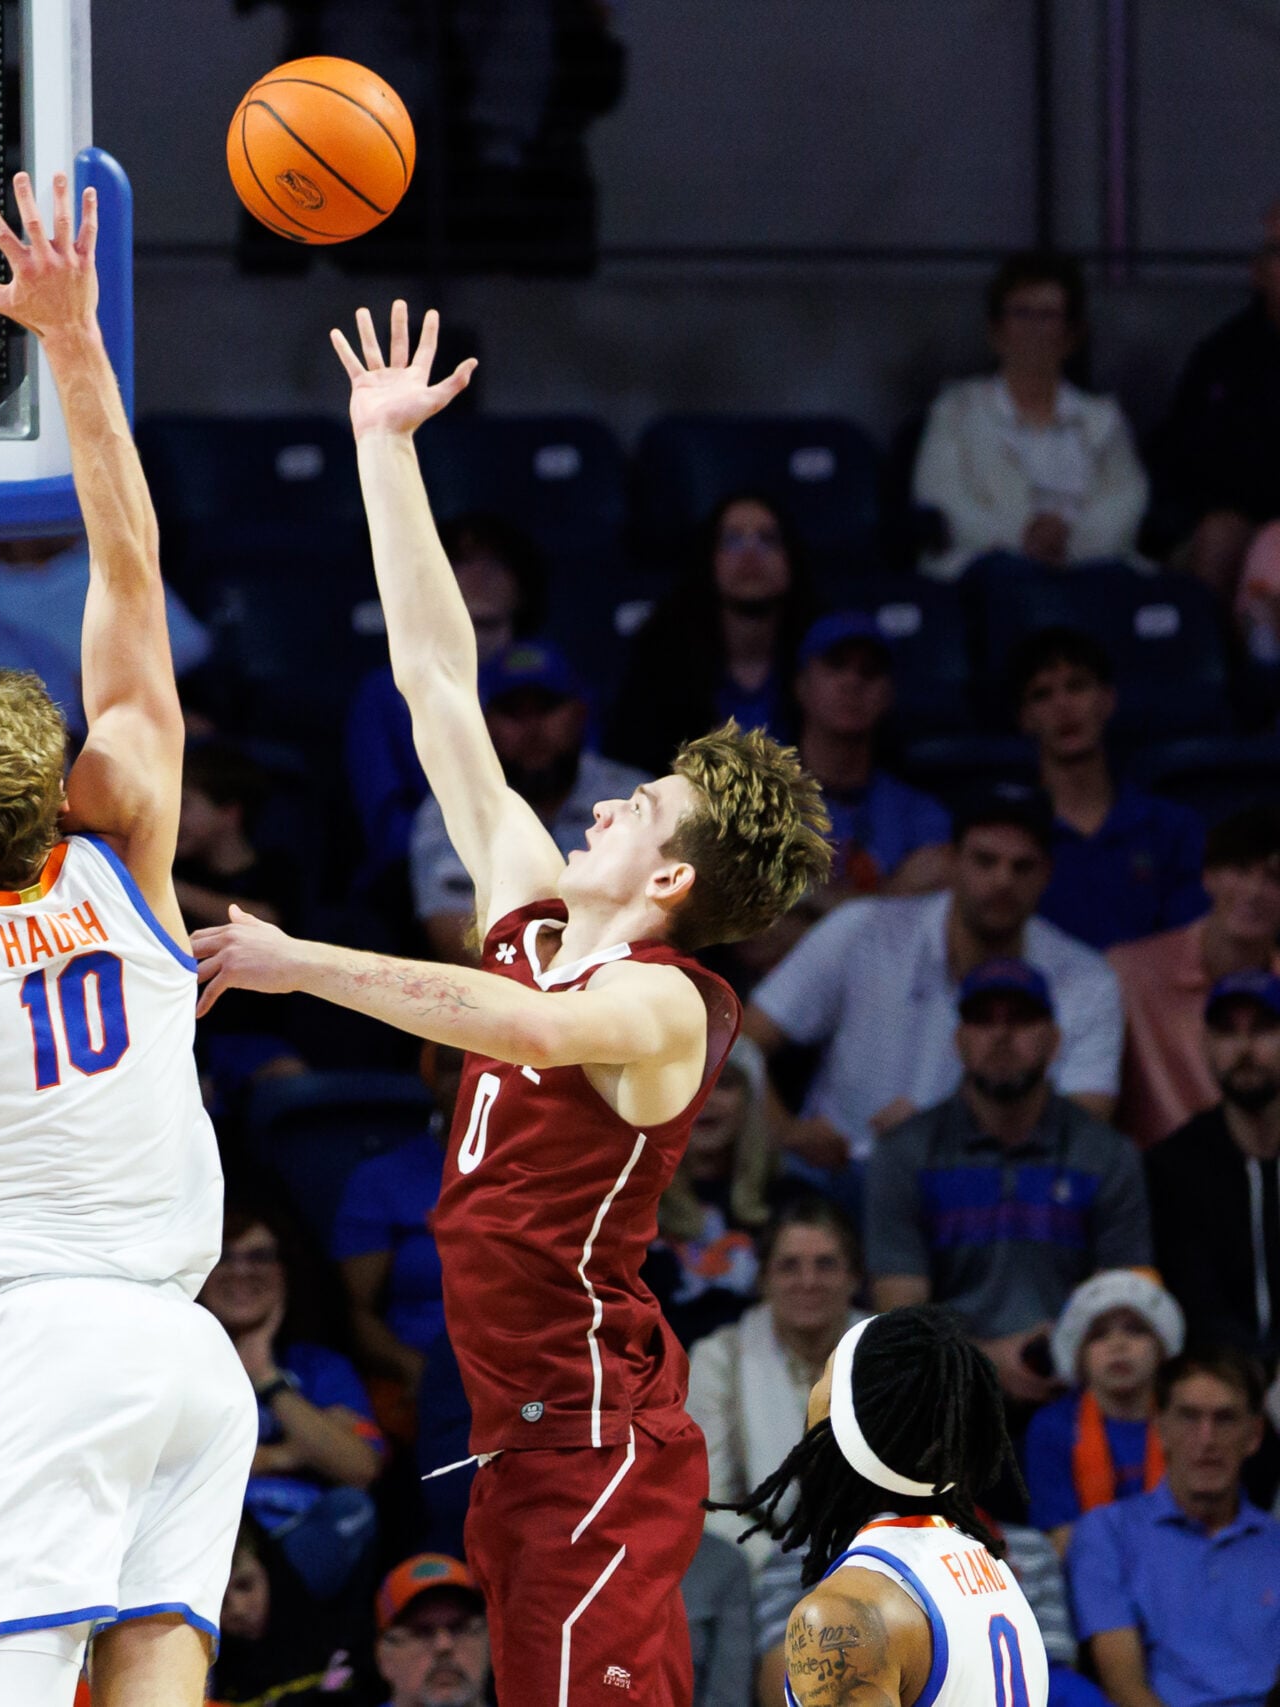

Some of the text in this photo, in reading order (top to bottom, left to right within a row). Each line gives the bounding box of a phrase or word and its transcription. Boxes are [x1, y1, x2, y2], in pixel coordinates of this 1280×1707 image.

[20, 950, 130, 1090] 10
[458, 1072, 501, 1175] 0
[988, 1613, 1031, 1707] 0
